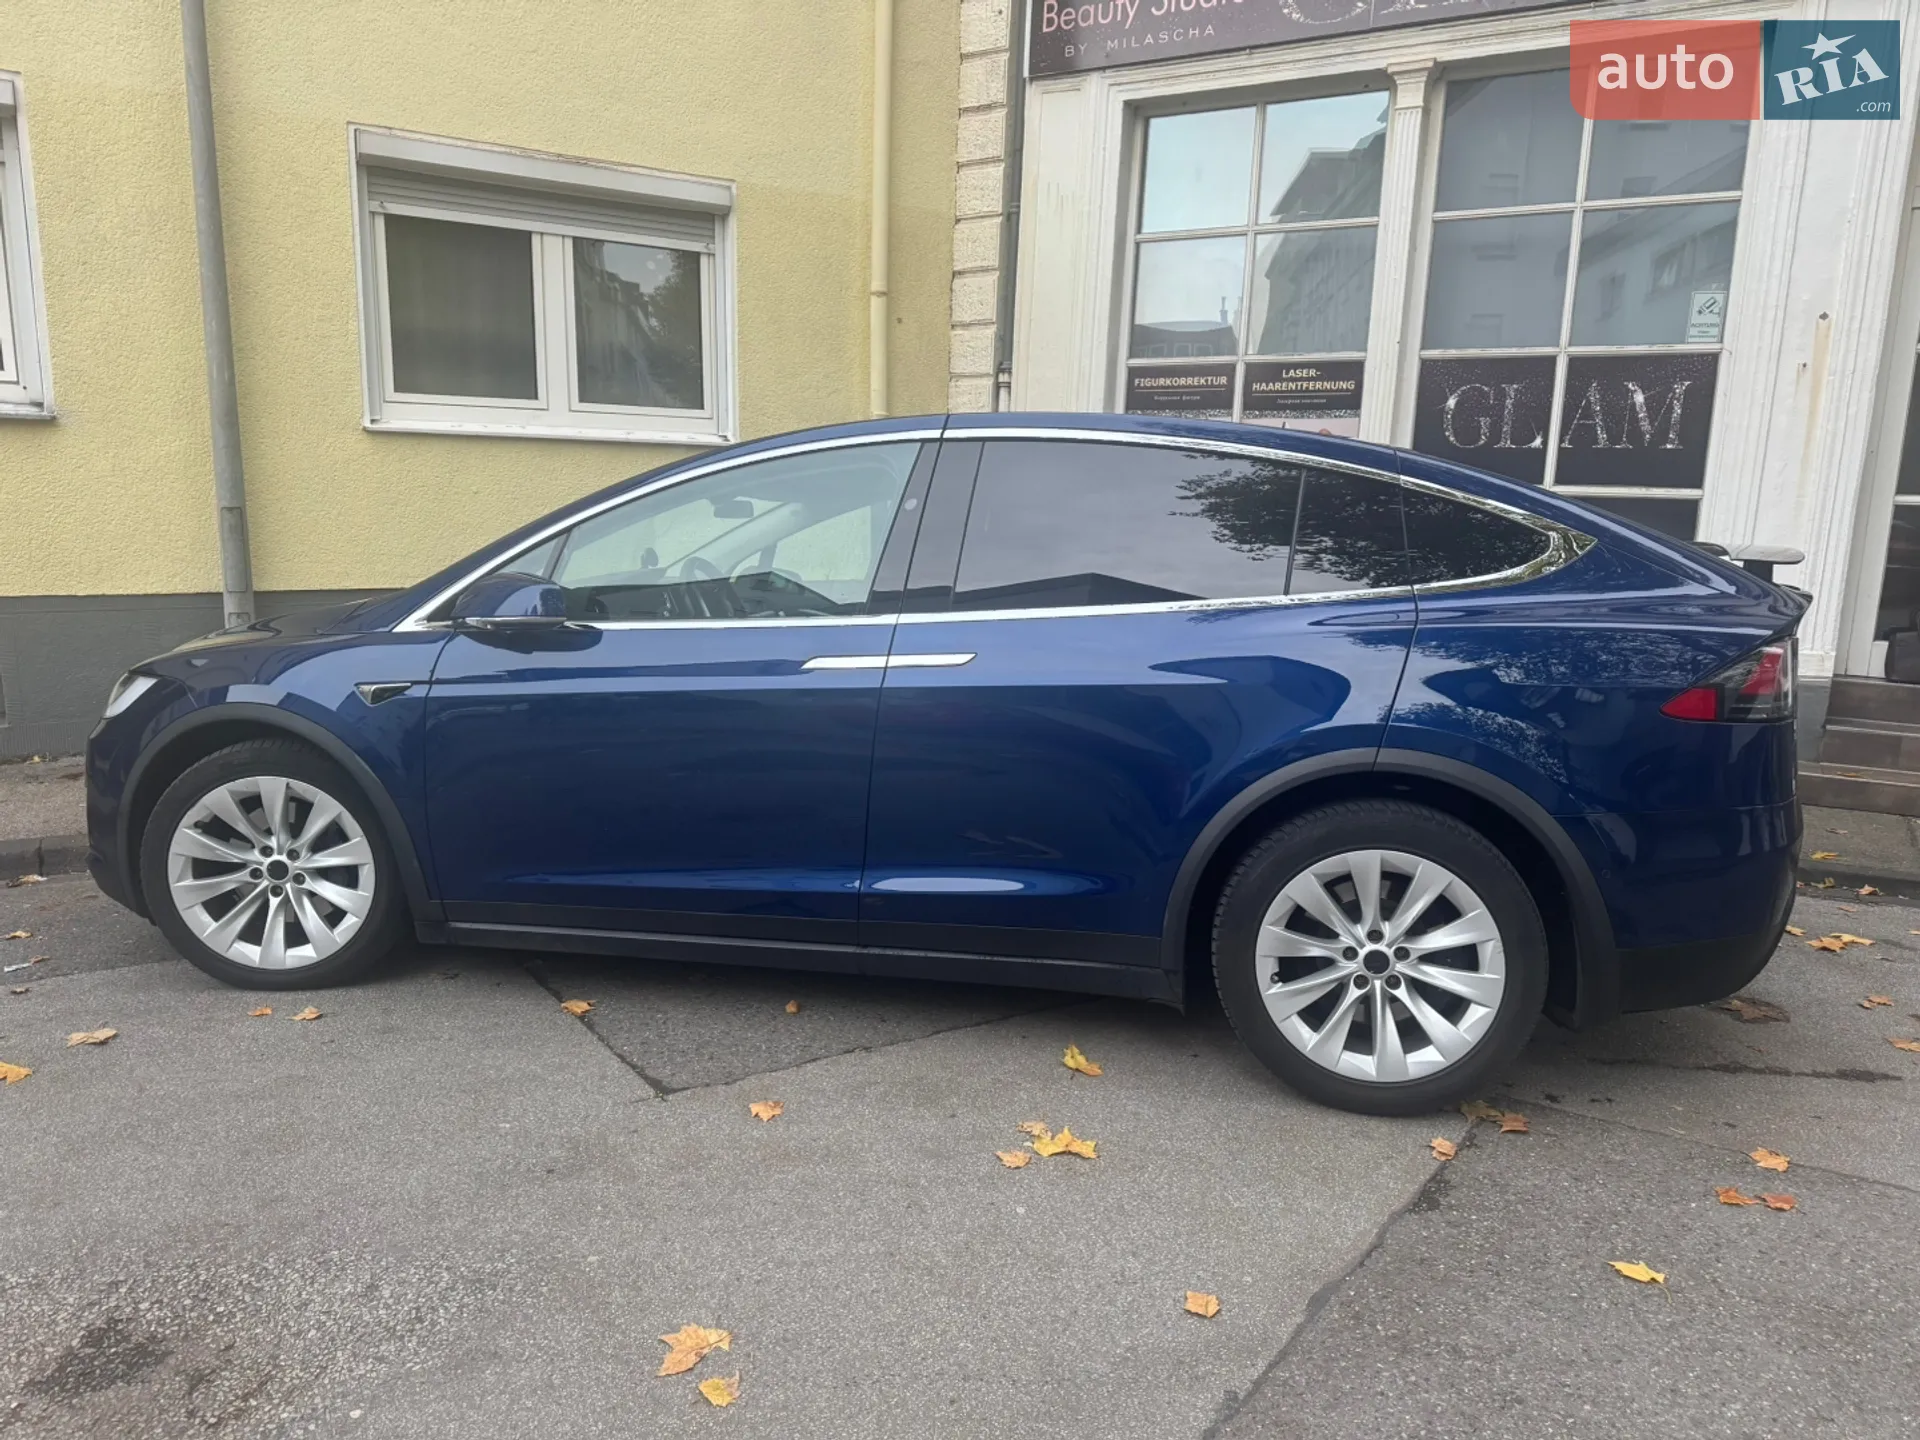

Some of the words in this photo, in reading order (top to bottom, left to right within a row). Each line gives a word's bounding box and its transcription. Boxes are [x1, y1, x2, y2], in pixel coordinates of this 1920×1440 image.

[1042, 0, 1140, 33] Beauty
[1064, 43, 1088, 58] BY
[1106, 24, 1215, 50] MILASCHA
[1134, 376, 1228, 387] FIGURKORREKTUR
[1282, 368, 1322, 378] LASER-
[1252, 380, 1356, 392] HAARENTFERNUNG
[1442, 381, 1692, 449] GLAM
